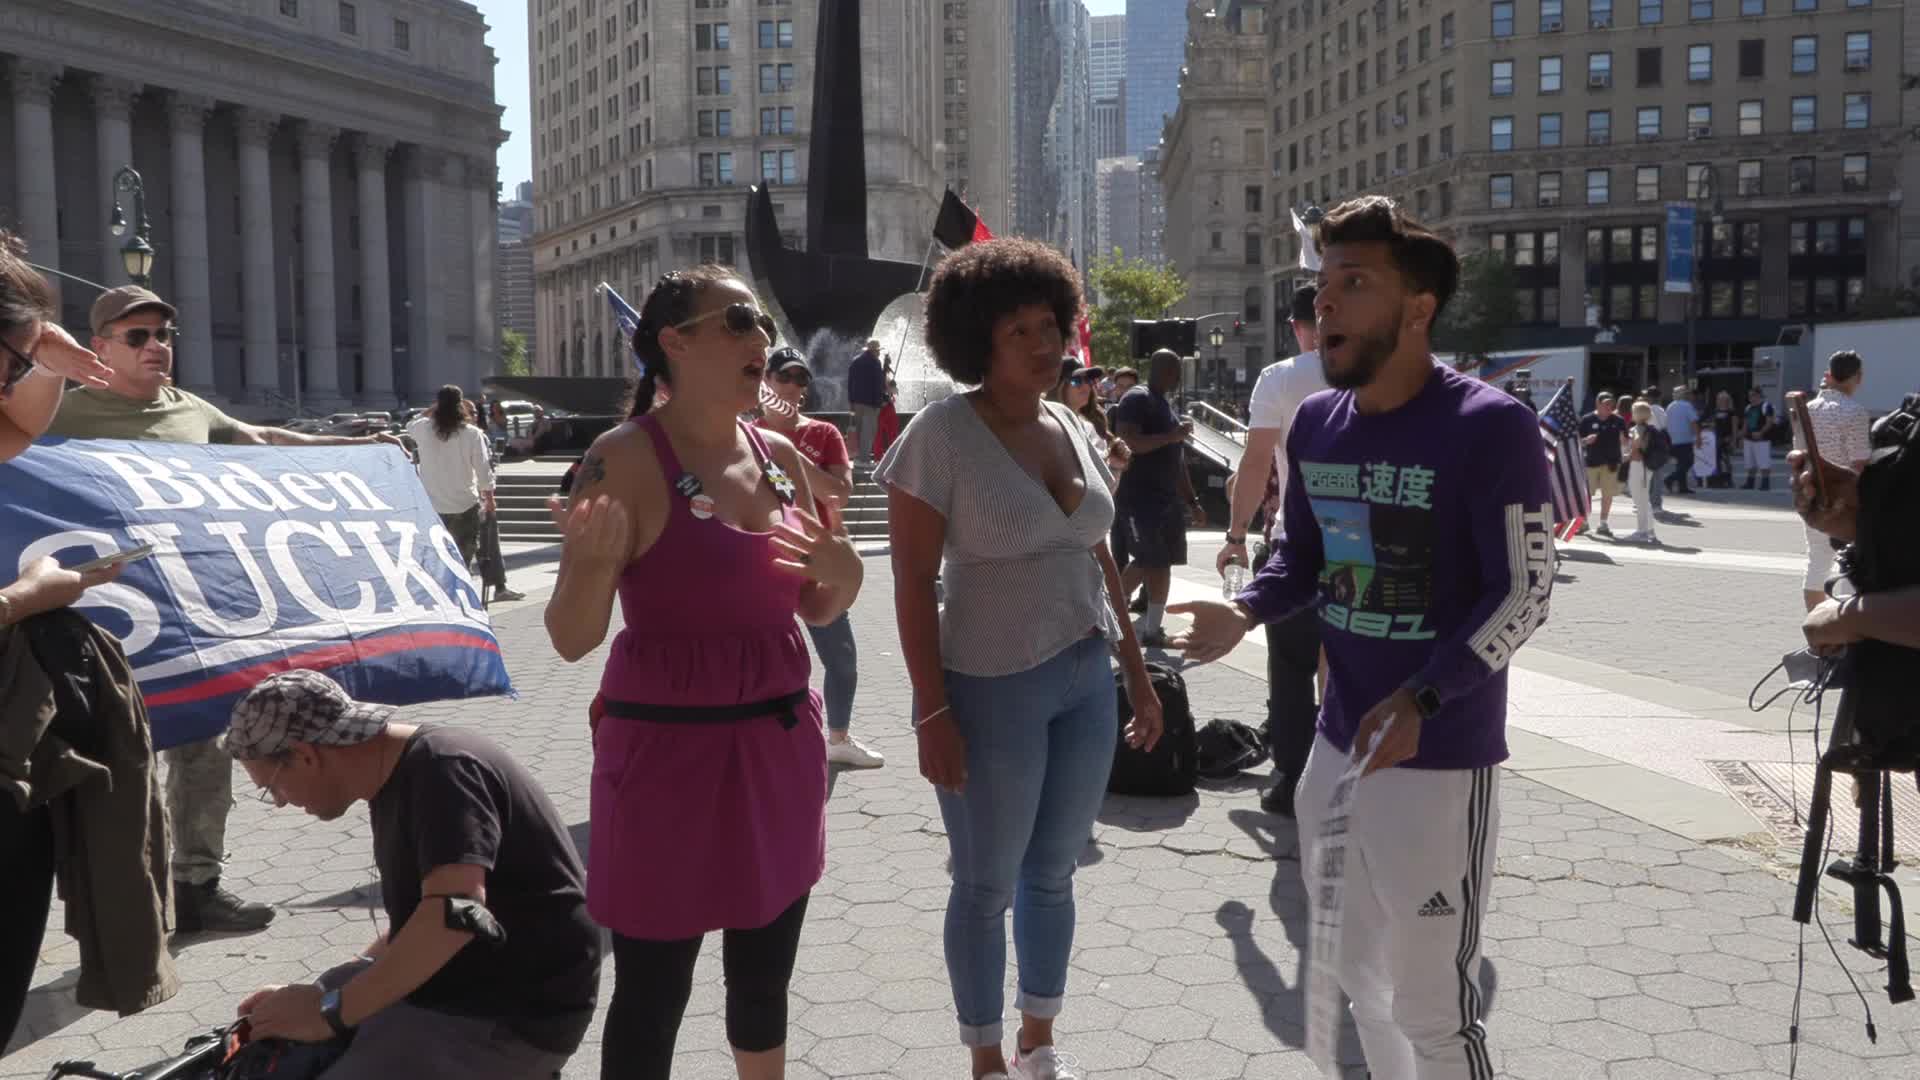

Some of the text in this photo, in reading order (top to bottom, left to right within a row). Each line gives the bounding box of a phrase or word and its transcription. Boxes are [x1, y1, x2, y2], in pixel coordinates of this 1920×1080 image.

[80, 451, 394, 512] Biden
[1361, 461, 1436, 511] 速度
[19, 519, 490, 657] SUCKS
[1417, 906, 1457, 917] adidas
